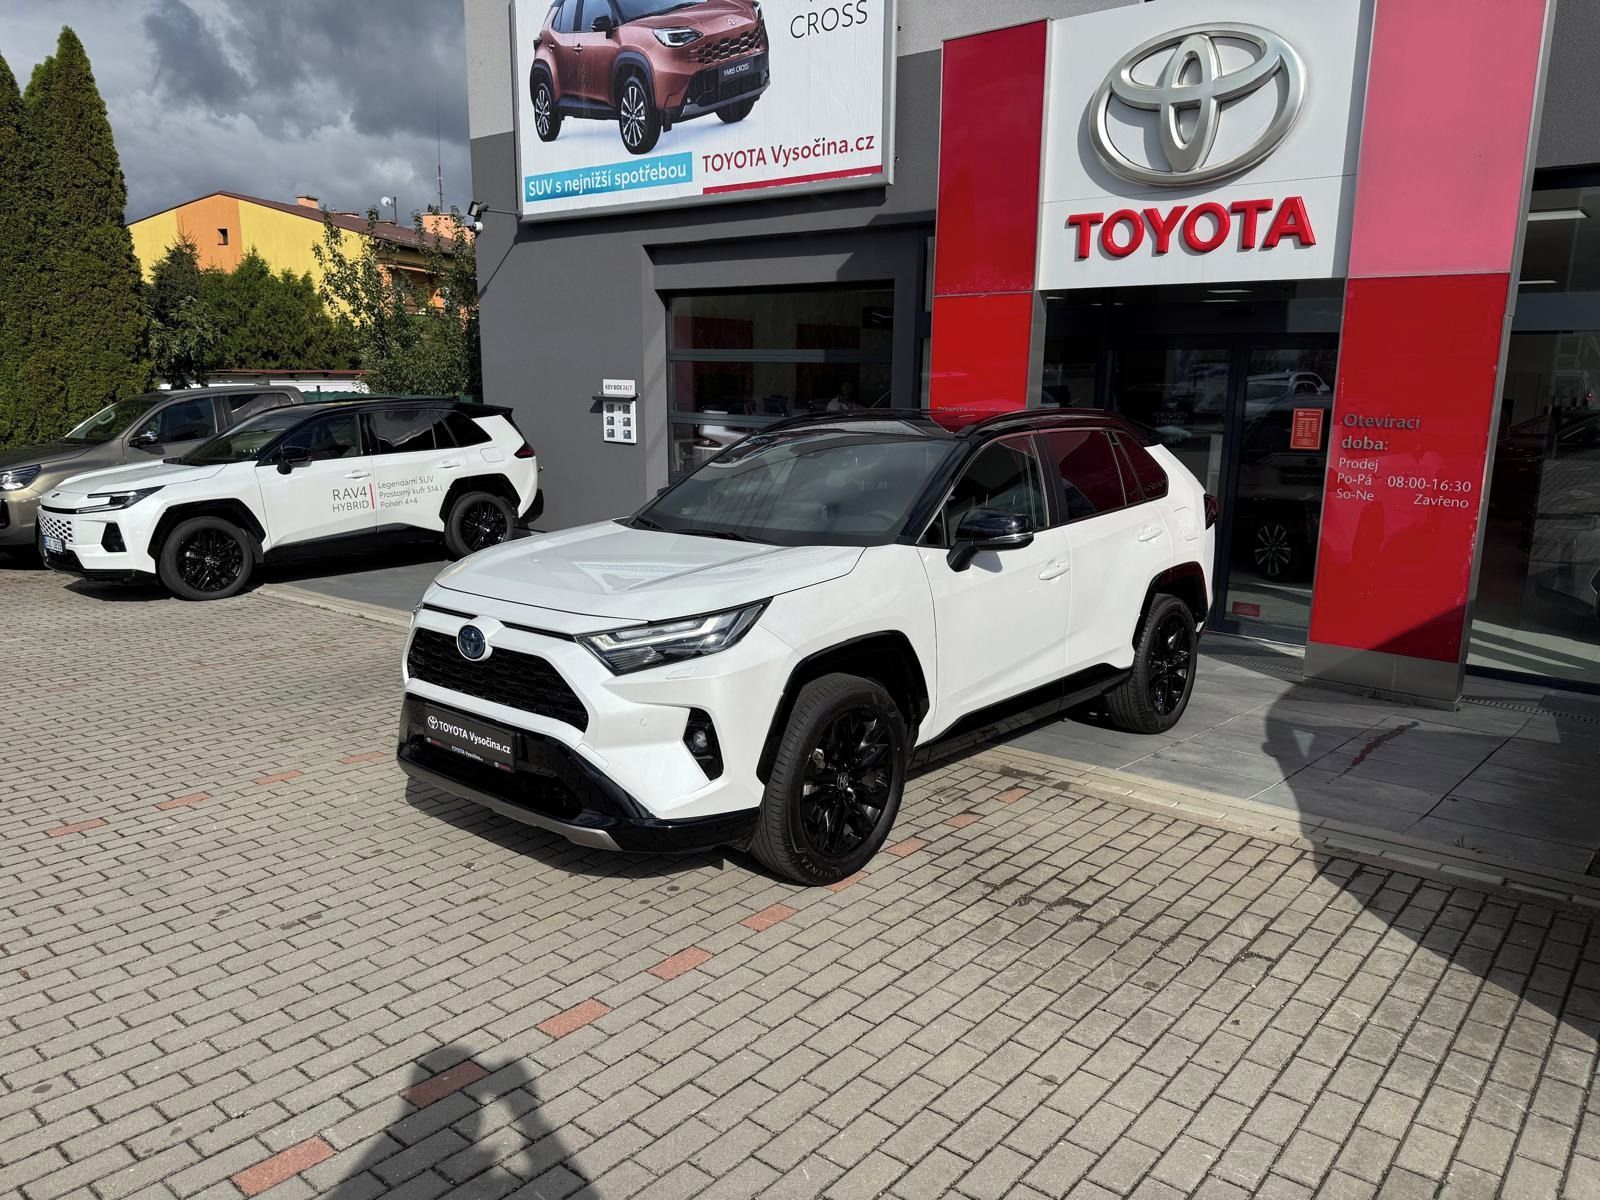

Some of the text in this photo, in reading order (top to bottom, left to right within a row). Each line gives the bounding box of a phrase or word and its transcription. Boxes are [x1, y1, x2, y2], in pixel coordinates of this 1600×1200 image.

[790, 0, 868, 39] CROSS
[702, 135, 875, 173] TOYOTA Vysočina.cz
[528, 162, 687, 197] SUV s nejnižší spotřebou
[1066, 196, 1316, 260] TOYOTA
[1343, 413, 1423, 430] Otevírací
[1341, 435, 1389, 451] doba:
[1338, 457, 1379, 474] Prodej
[419, 475, 434, 484] SUV
[1336, 472, 1472, 493] Po-Pá 08:00-16:30
[332, 486, 368, 500] RAV4
[412, 486, 425, 494] kufr
[1335, 488, 1470, 509] So-Ne Zavřeno
[332, 500, 369, 512] HYBRID
[380, 500, 403, 509] Pohon
[439, 720, 511, 754] TOYOTA Vysočina.cz
